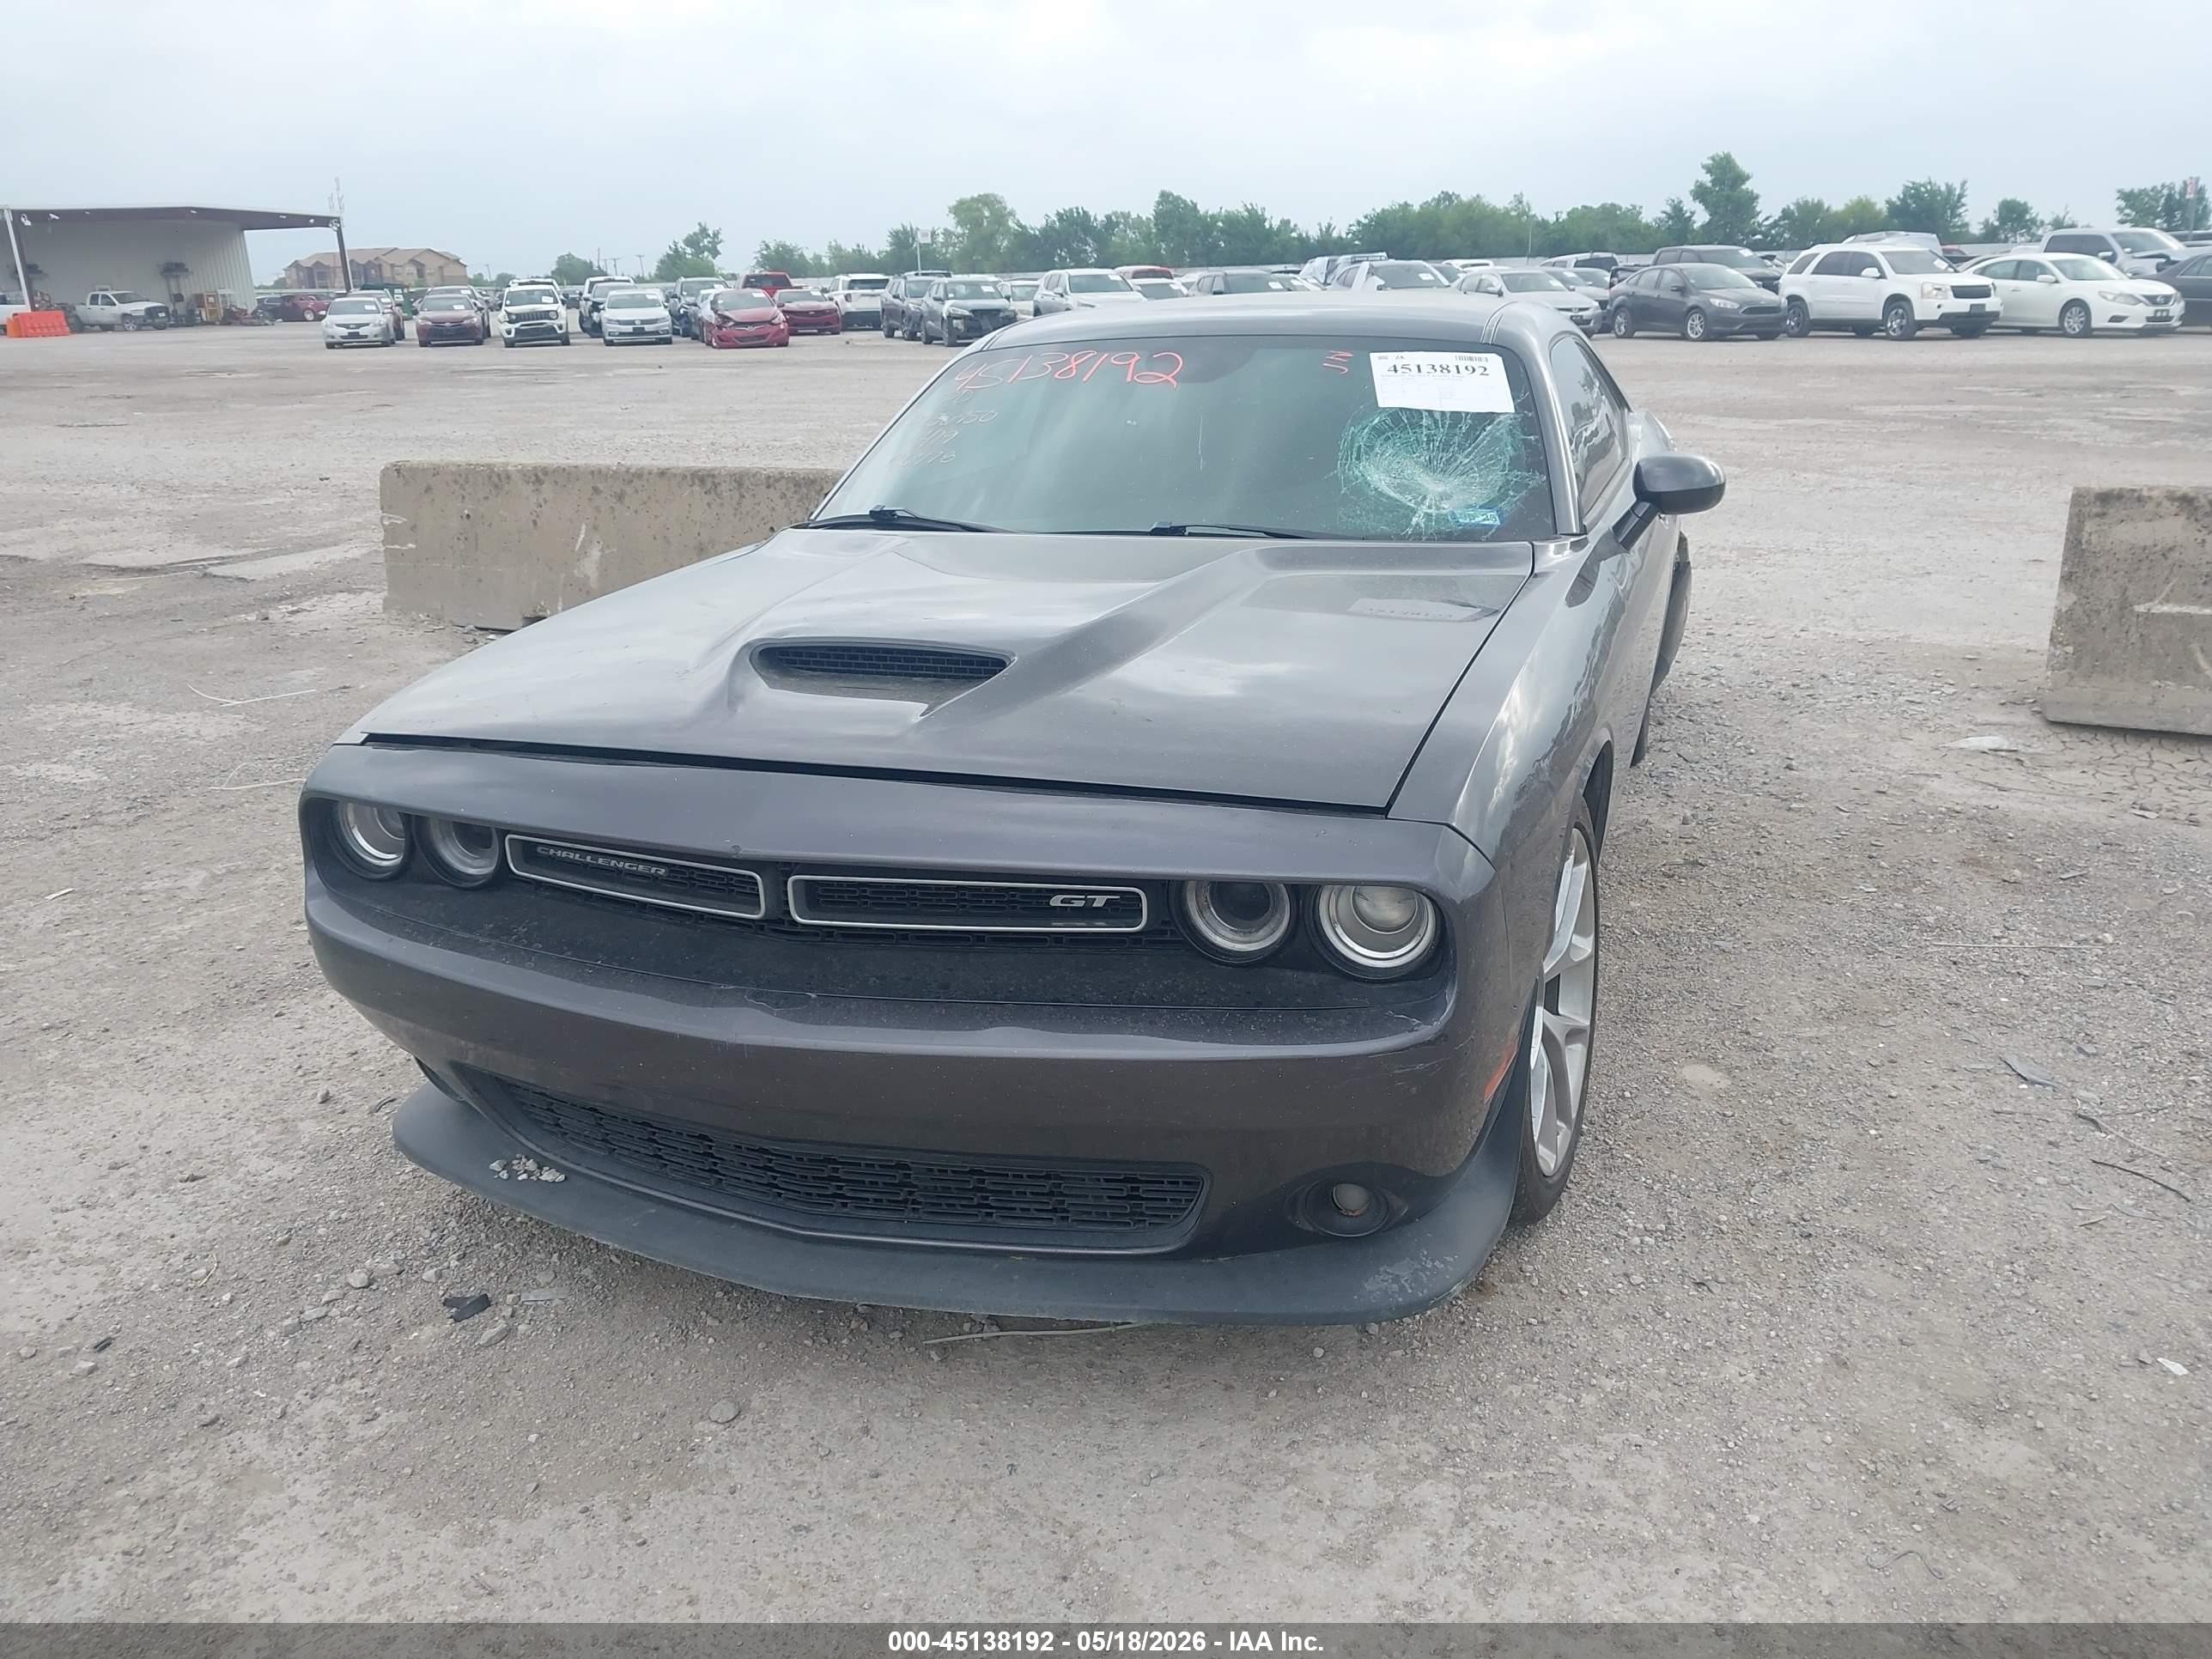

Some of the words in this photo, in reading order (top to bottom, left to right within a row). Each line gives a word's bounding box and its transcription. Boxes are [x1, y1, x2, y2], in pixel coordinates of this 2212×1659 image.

[954, 349, 1184, 391] 45138192
[1387, 362, 1491, 377] 45138192
[536, 845, 667, 876] CHALLENGER
[1048, 894, 1121, 908] GT
